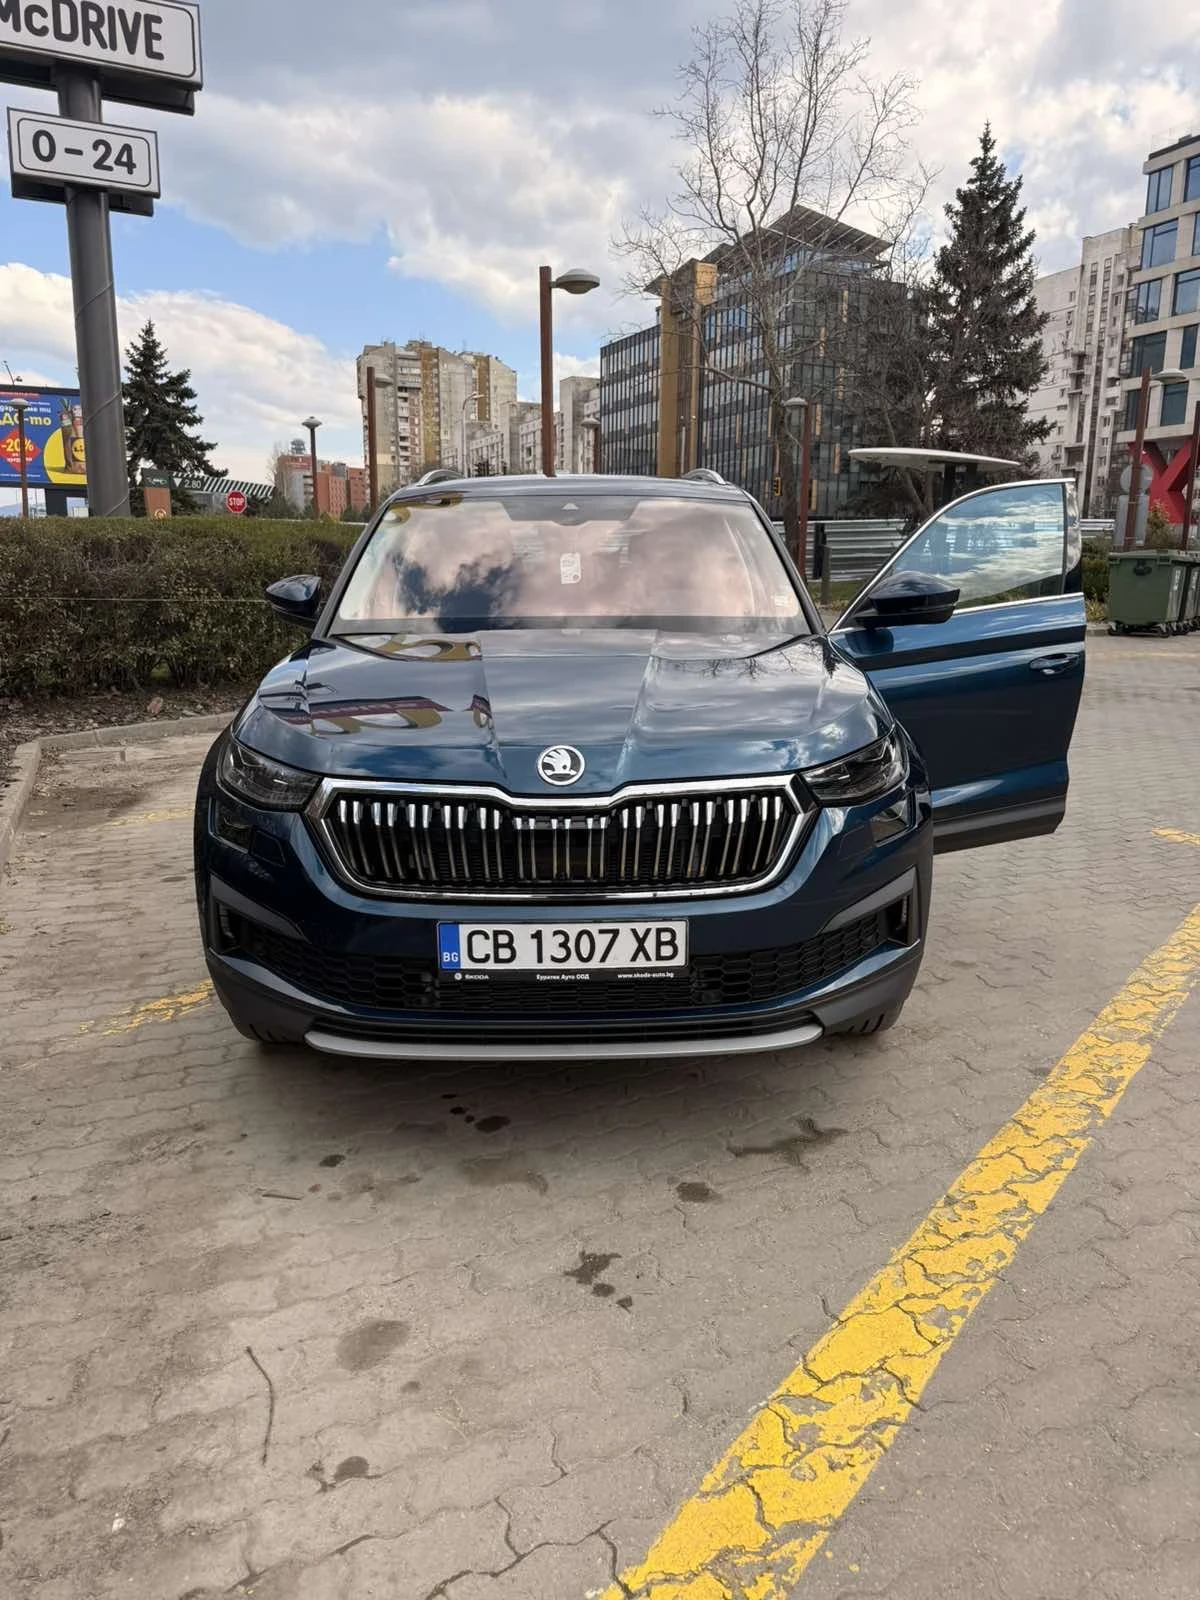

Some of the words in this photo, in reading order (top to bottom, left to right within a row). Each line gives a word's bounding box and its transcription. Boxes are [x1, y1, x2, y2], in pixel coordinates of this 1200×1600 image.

[0, 0, 164, 61] McDRIVE
[184, 479, 201, 489] 2.80
[229, 496, 245, 507] STOP
[466, 929, 517, 964] CB
[530, 928, 620, 964] 1307
[629, 927, 679, 962] XB
[443, 952, 459, 963] BG
[617, 971, 674, 979] www.skoda-auto.bg
